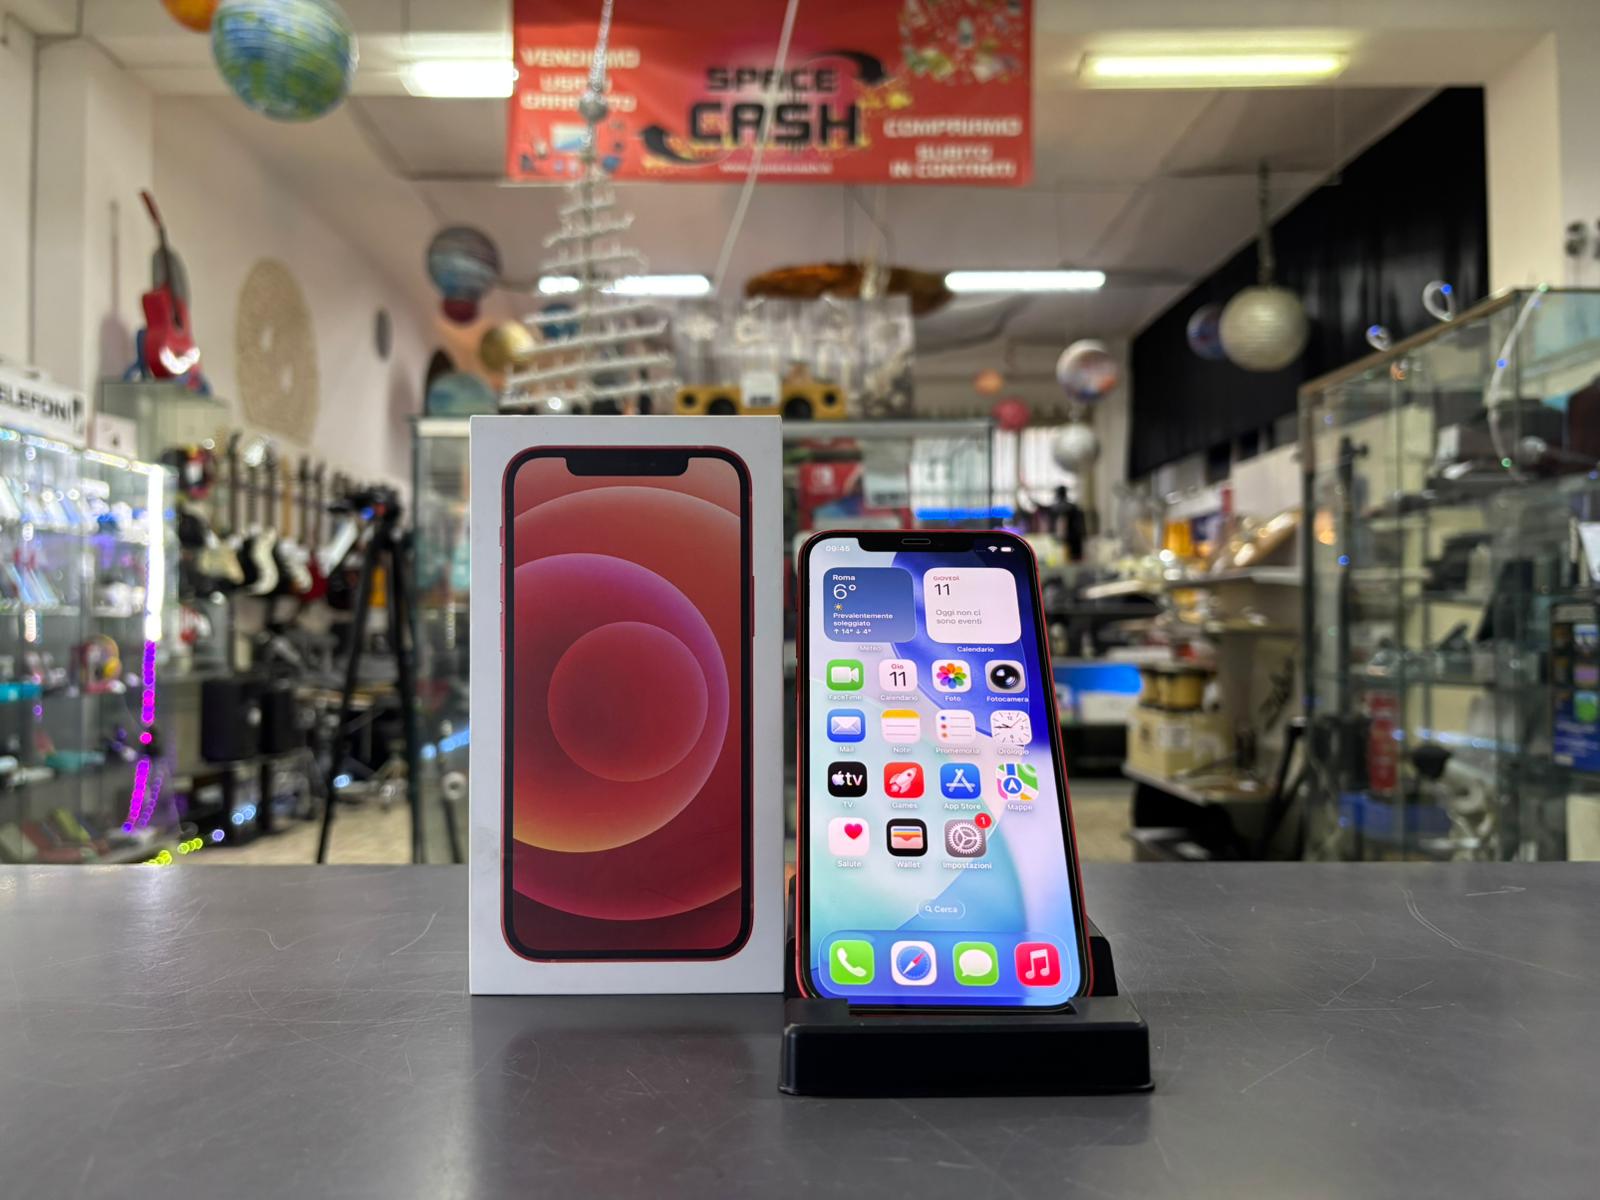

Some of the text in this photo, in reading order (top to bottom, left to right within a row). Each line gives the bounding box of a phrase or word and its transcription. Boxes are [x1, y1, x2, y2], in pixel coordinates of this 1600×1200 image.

[520, 47, 641, 69] VENDIMO
[706, 68, 838, 93] SPACE
[690, 102, 858, 146] CASH
[883, 117, 1023, 138] COMPRIAMO
[915, 144, 994, 161] SUBITO
[825, 544, 851, 553] 09:45
[833, 583, 857, 600] 6°
[934, 583, 951, 596] 11
[832, 612, 894, 620] Prevalentemente
[935, 609, 956, 617] Oggi
[833, 620, 871, 628] soleggiato
[889, 671, 907, 688] 11
[892, 746, 912, 754] Note
[845, 772, 864, 786] tv
[891, 801, 918, 809] Games
[943, 802, 981, 811] App Store
[1007, 803, 1033, 812] Mappe
[837, 859, 862, 868] Salute
[896, 861, 921, 869] Wallet
[943, 861, 993, 870] Impostazioni
[934, 905, 958, 914] Cerca
